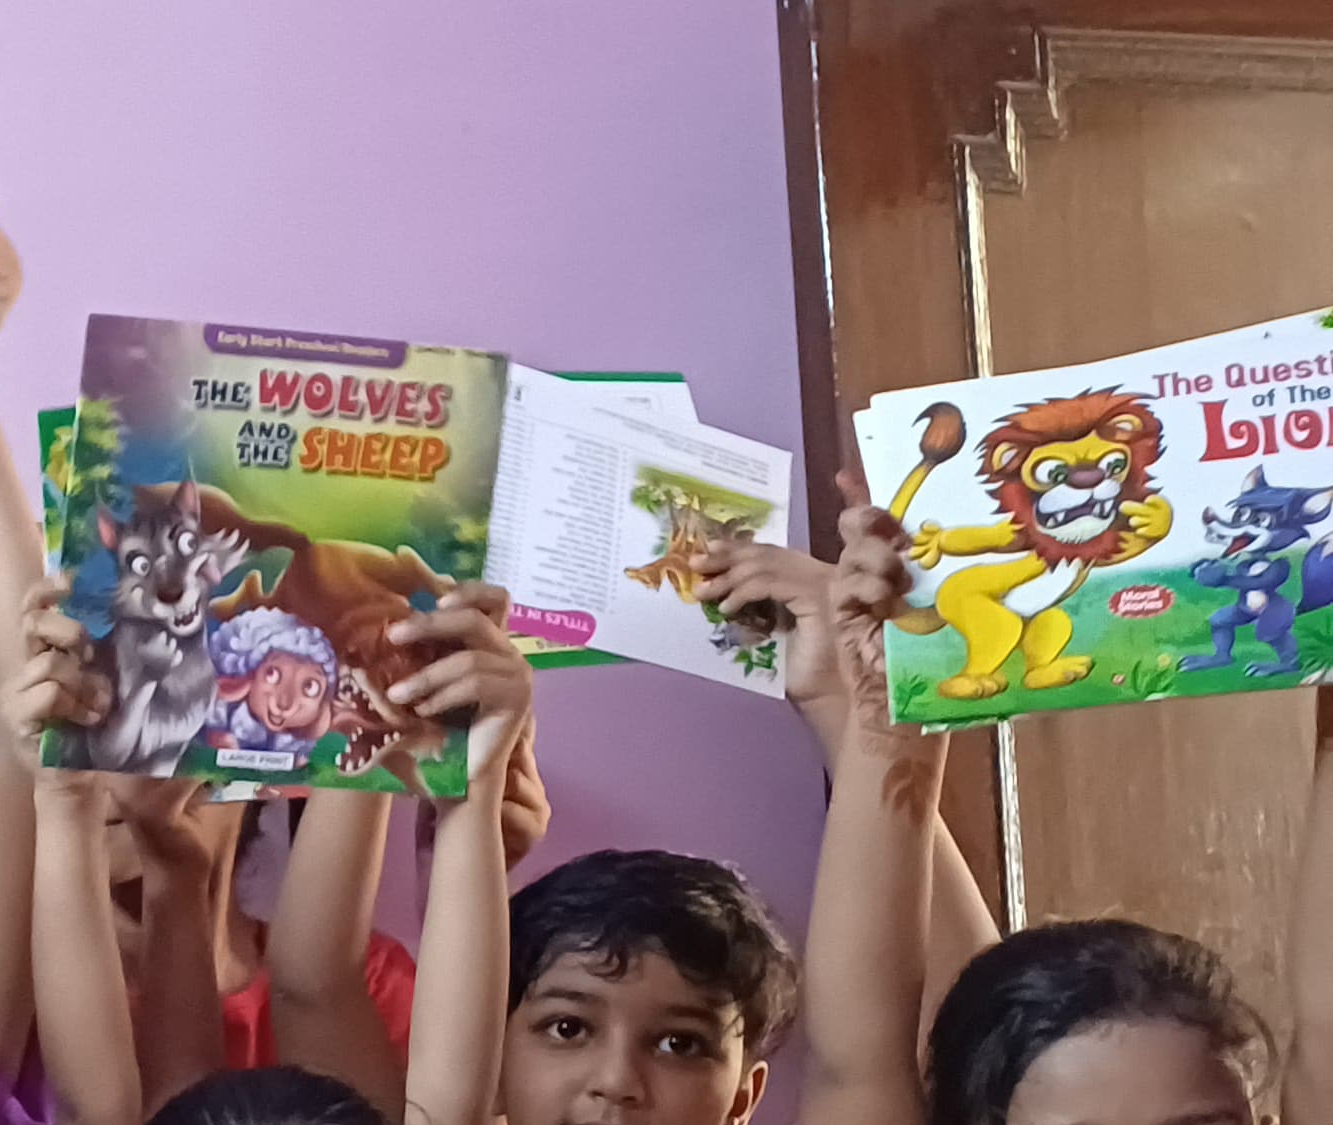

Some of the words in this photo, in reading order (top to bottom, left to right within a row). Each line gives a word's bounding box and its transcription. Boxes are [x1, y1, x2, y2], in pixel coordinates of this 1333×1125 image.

[192, 379, 250, 406] THE
[259, 368, 452, 427] WOLVES
[1152, 372, 1213, 398] The
[1252, 388, 1276, 407] of
[1286, 384, 1332, 404] The
[238, 420, 293, 441] AND
[236, 442, 289, 466] THE
[299, 427, 450, 480] SHEEP
